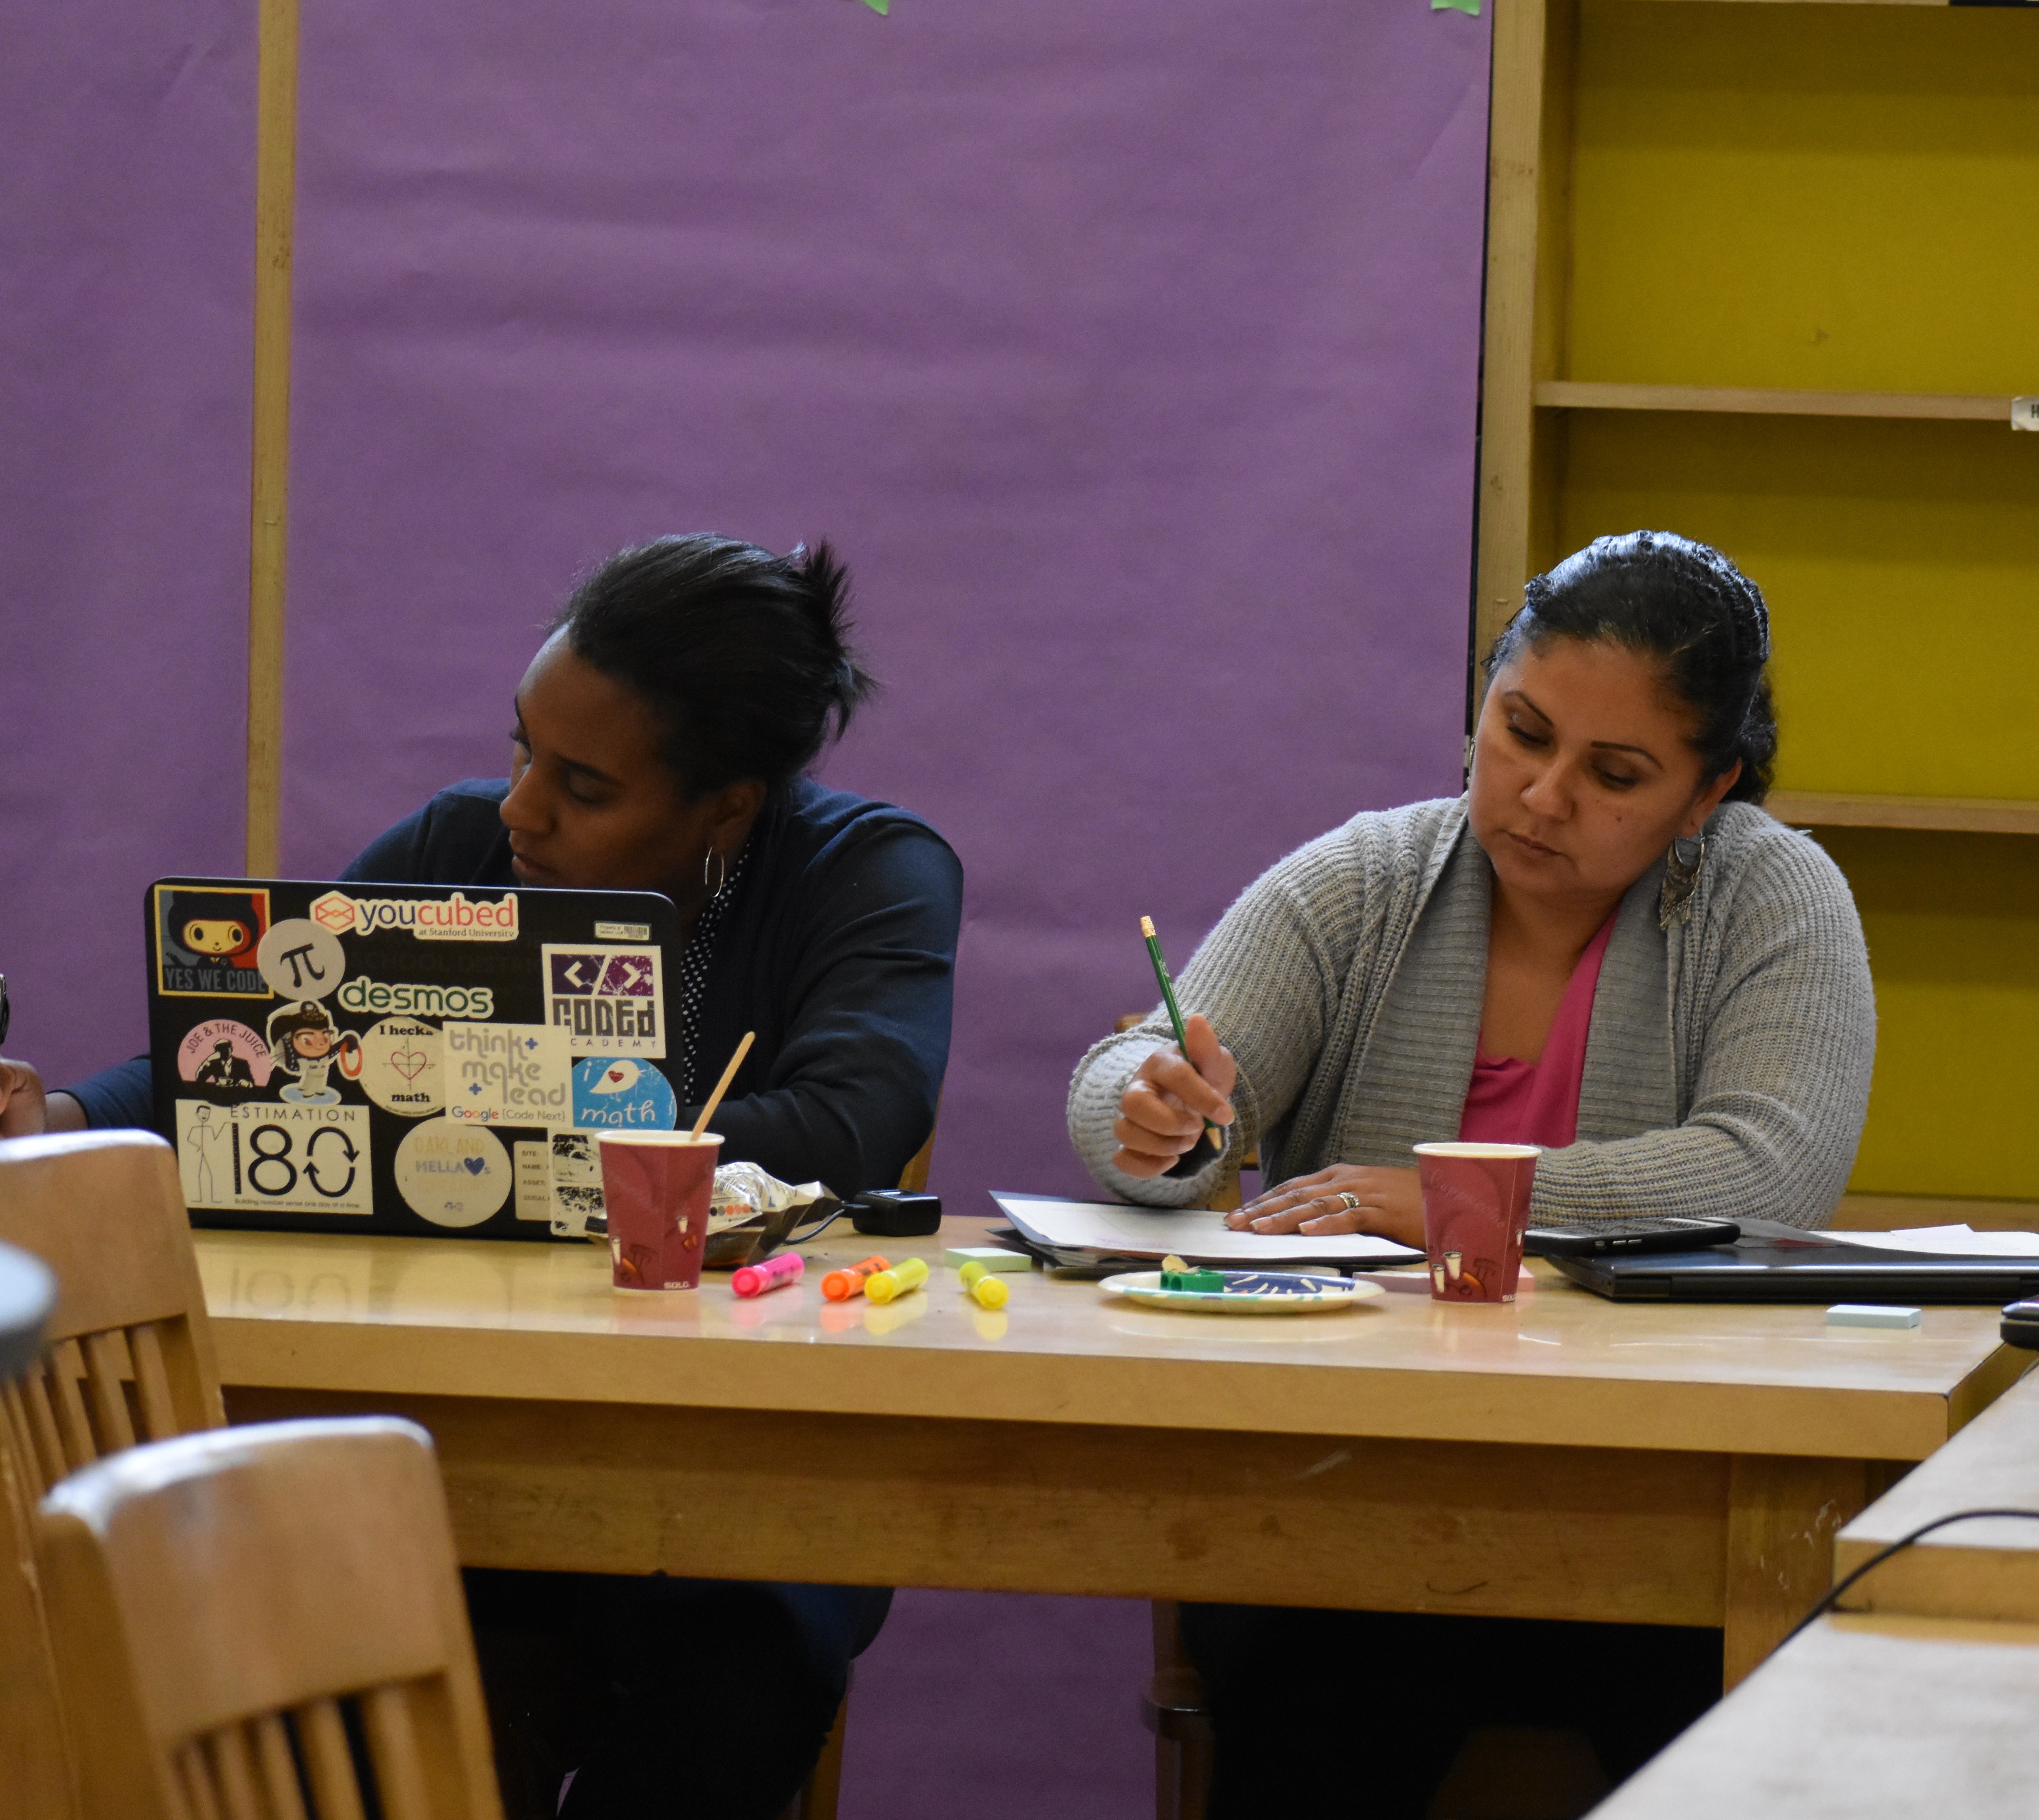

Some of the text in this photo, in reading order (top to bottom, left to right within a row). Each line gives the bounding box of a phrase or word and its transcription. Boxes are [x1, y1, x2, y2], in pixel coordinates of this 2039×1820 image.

[360, 897, 514, 930] youcubed
[429, 928, 466, 936] Stanford
[165, 968, 266, 992] YES WE CODE
[343, 979, 489, 1014] desmos
[379, 1025, 386, 1035] I
[186, 1023, 267, 1058] JOE & THE JUICE
[571, 1039, 656, 1048] CADEMY
[391, 1092, 431, 1102] math
[230, 1103, 355, 1121] ESTIMATION
[452, 1106, 499, 1122] Google
[581, 1099, 656, 1125] math
[415, 1136, 485, 1155] OAKLAND
